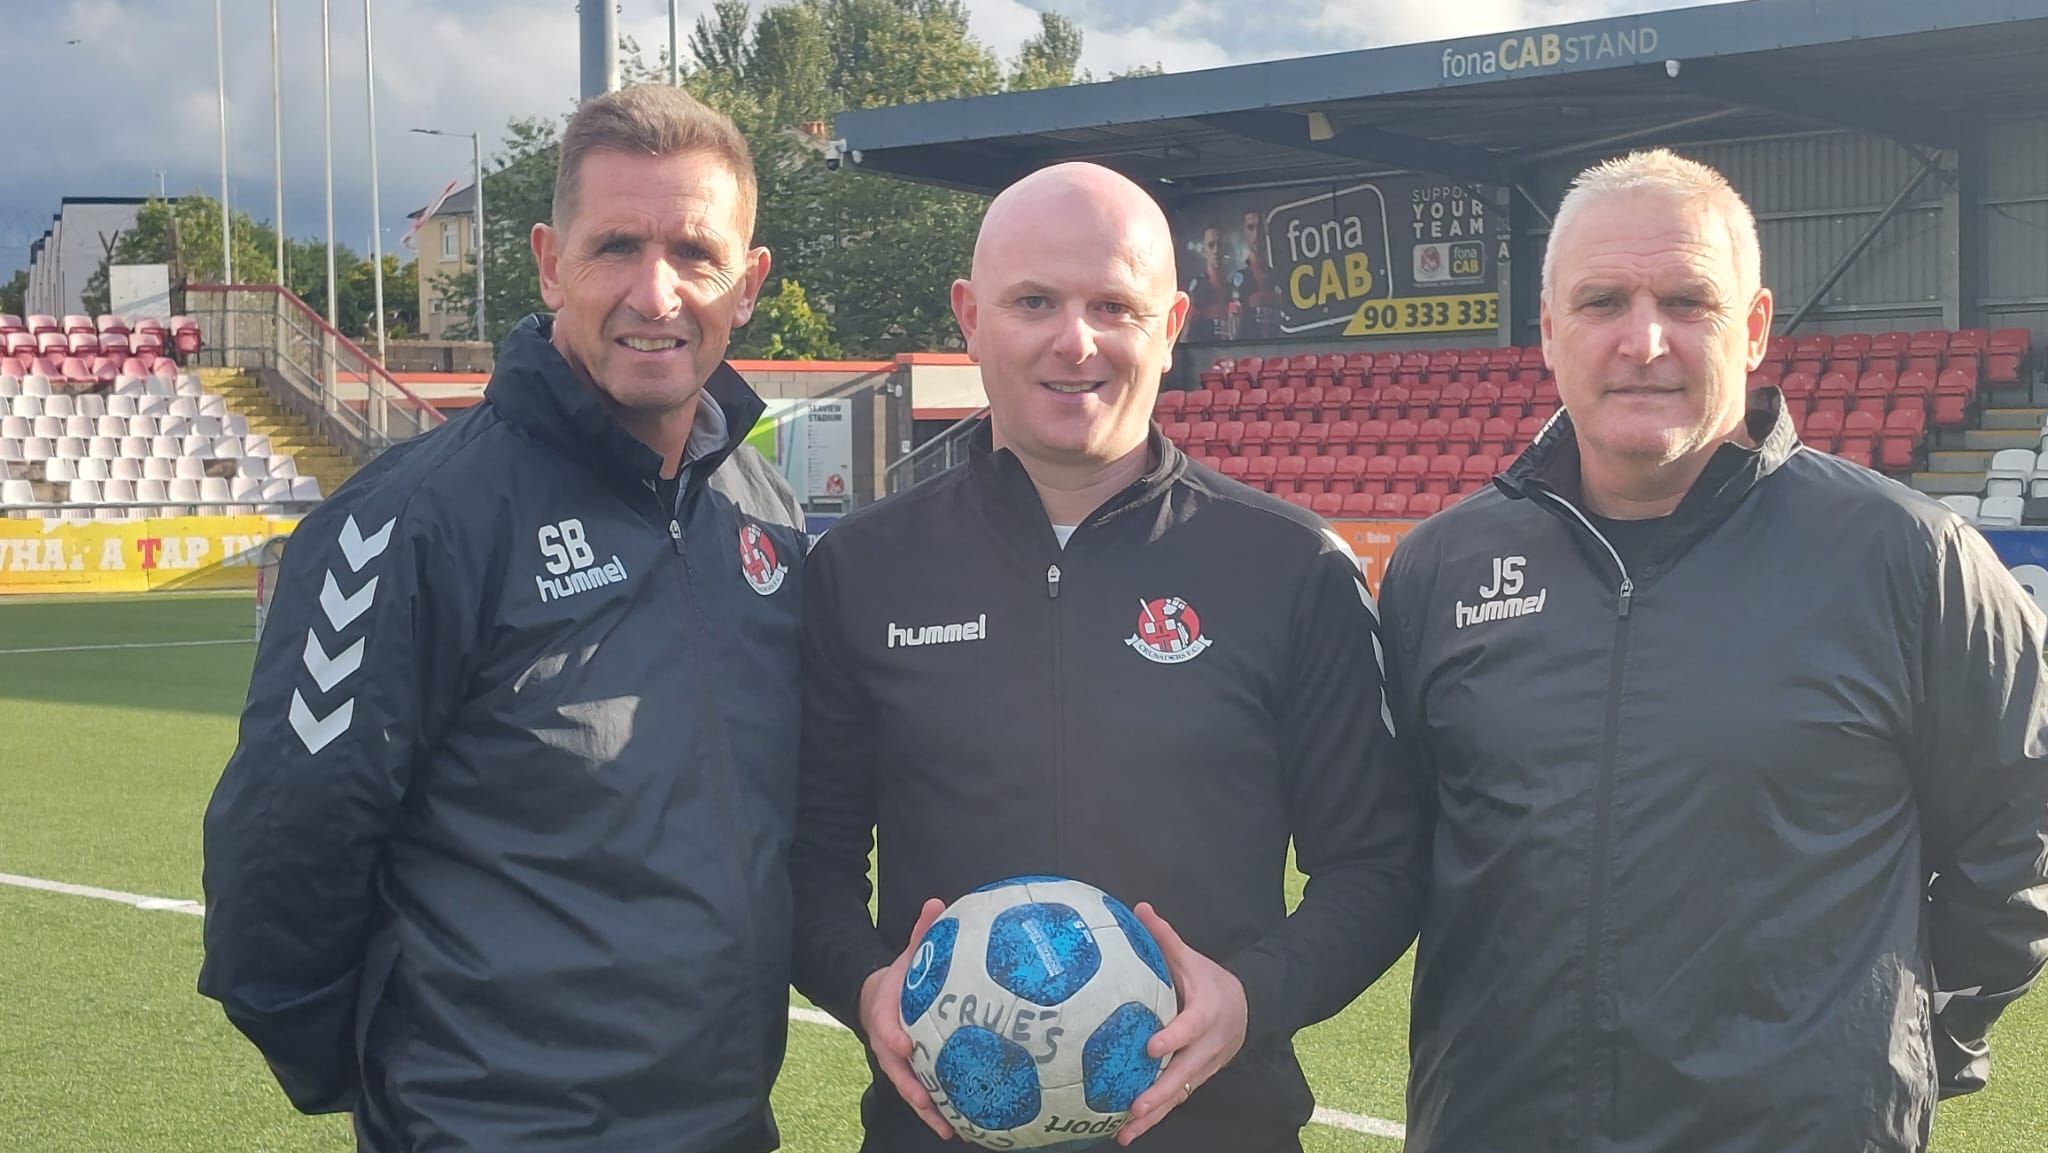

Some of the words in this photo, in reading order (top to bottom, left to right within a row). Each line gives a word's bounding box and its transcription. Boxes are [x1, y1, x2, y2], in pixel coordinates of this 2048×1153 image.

[1564, 27, 1658, 63] STAND
[1412, 198, 1484, 220] YOUR
[1287, 216, 1363, 261] fona
[1412, 218, 1484, 239] TEAM
[1290, 252, 1372, 310] CAB
[1452, 259, 1479, 274] CAB
[1363, 304, 1398, 330] 90
[1404, 302, 1449, 327] 333
[1456, 299, 1498, 325] 333
[808, 413, 842, 422] STADIUM
[99, 538, 126, 570] A
[137, 537, 209, 569] TAP
[538, 518, 595, 575] SB
[535, 554, 629, 603] hummel
[1479, 556, 1526, 597] JS
[1456, 588, 1546, 628] hummel
[888, 613, 986, 648] hummel
[1044, 1115, 1123, 1135] sport
